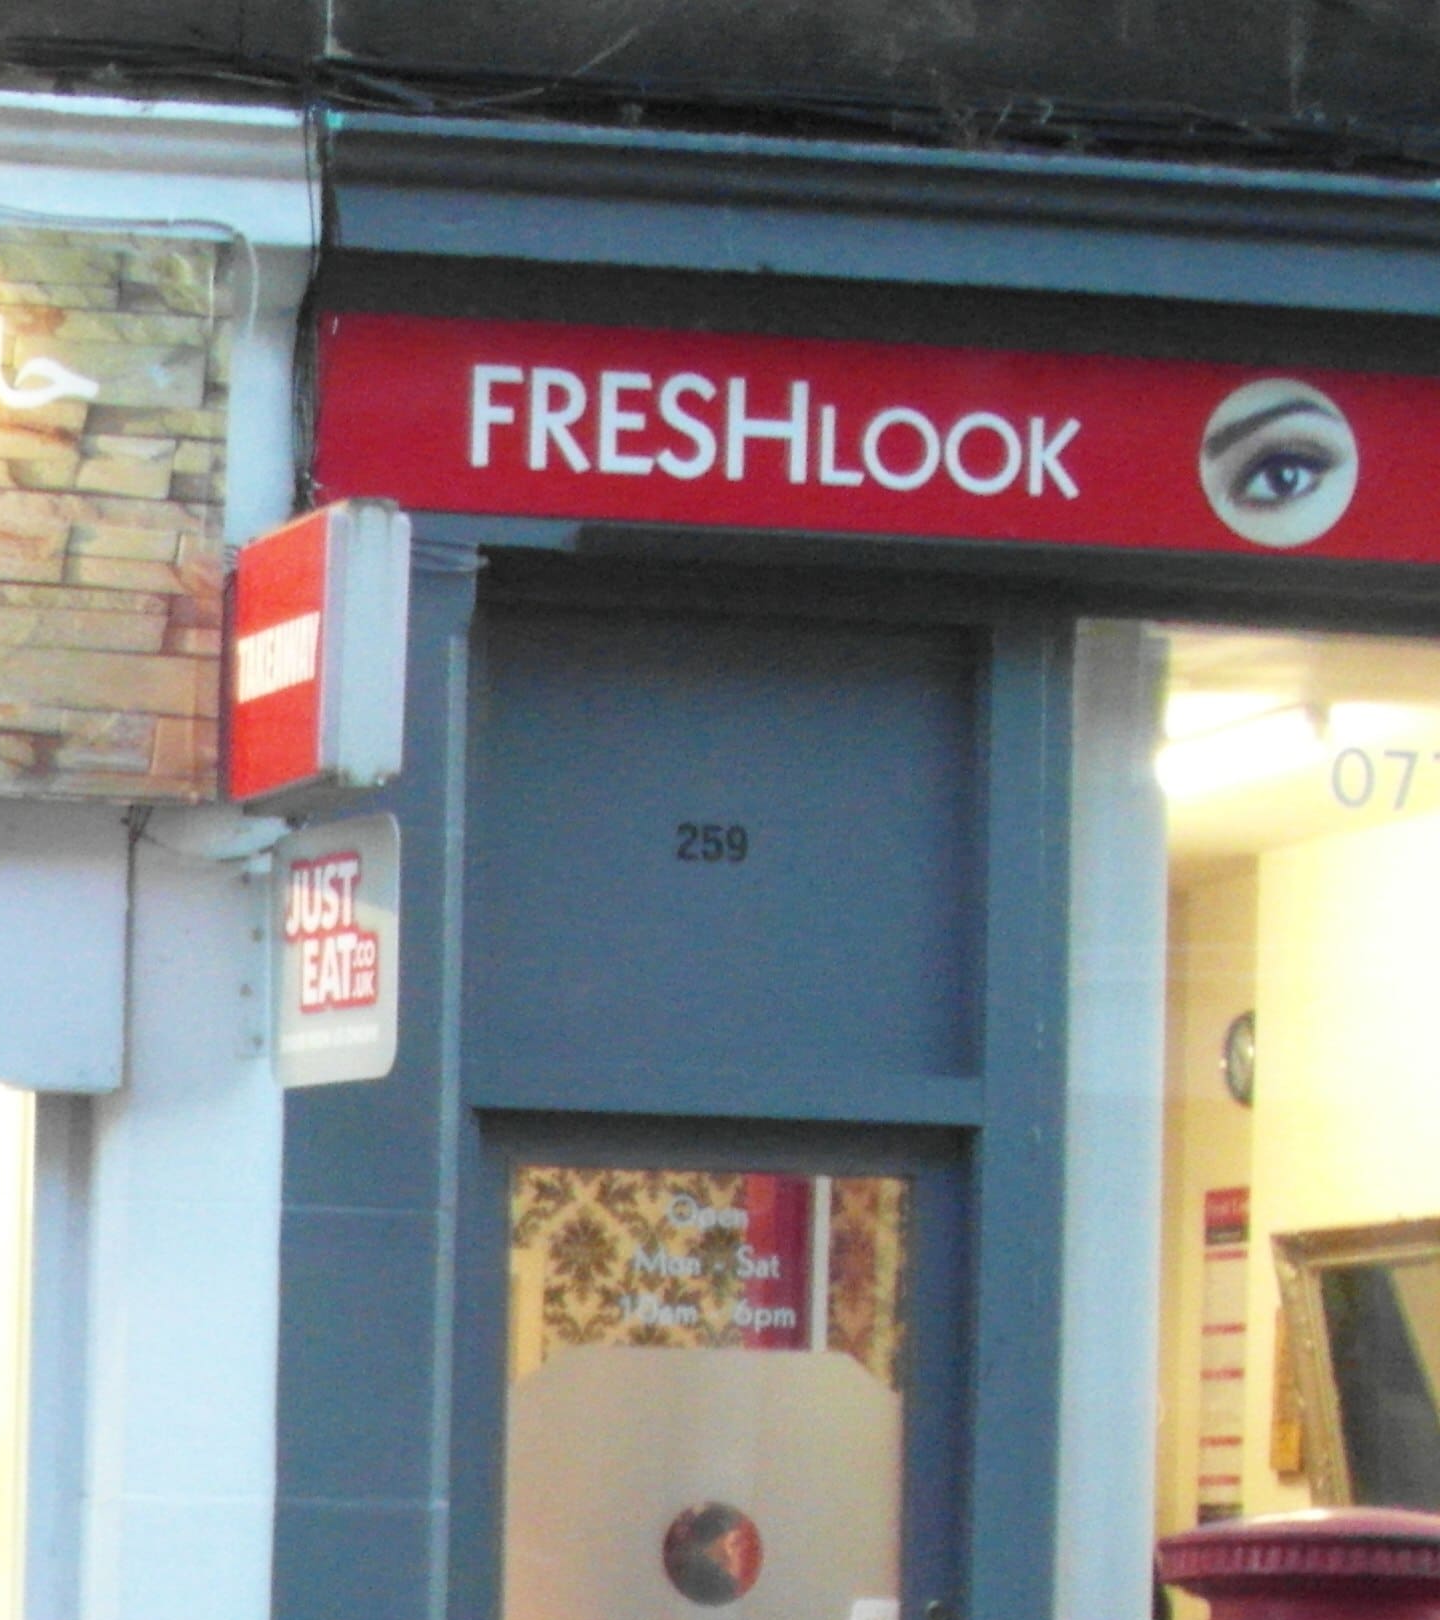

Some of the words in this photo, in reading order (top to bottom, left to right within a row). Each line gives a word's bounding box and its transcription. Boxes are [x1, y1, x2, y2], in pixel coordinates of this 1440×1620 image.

[470, 364, 1081, 500] FRESHLOOK
[1331, 746, 1440, 812] 07
[676, 822, 749, 863] 259
[285, 858, 359, 937] JUST
[302, 932, 358, 1006] EAT
[633, 1242, 702, 1276] Mon
[735, 1243, 782, 1280] Sat
[733, 1299, 797, 1333] 6pm
